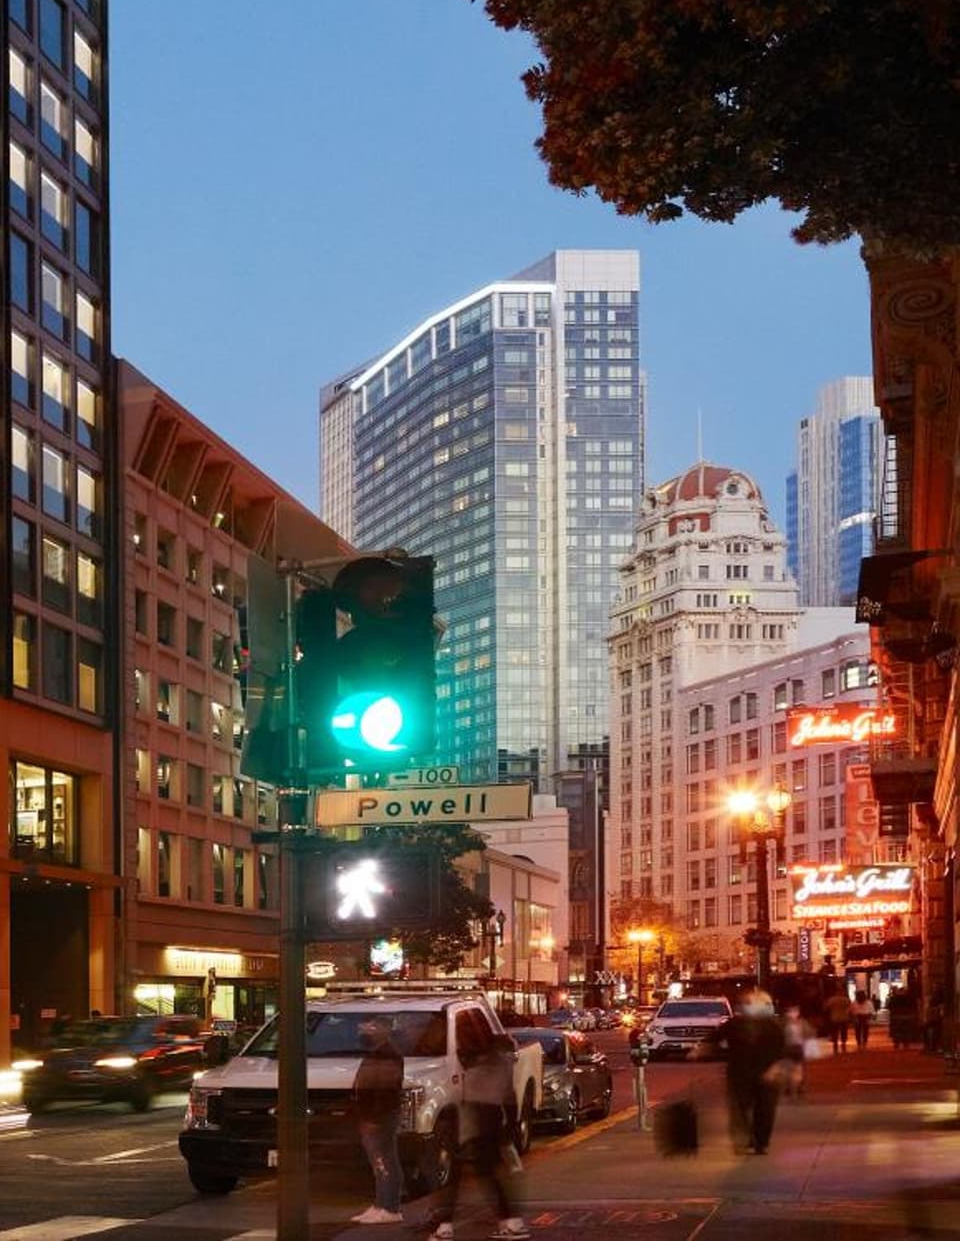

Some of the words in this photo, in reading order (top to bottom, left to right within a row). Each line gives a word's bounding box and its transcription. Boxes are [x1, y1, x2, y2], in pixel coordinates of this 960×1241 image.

[417, 769, 453, 784] 100
[357, 793, 487, 818] Powell
[795, 868, 856, 903] John's
[856, 868, 912, 899] Grill
